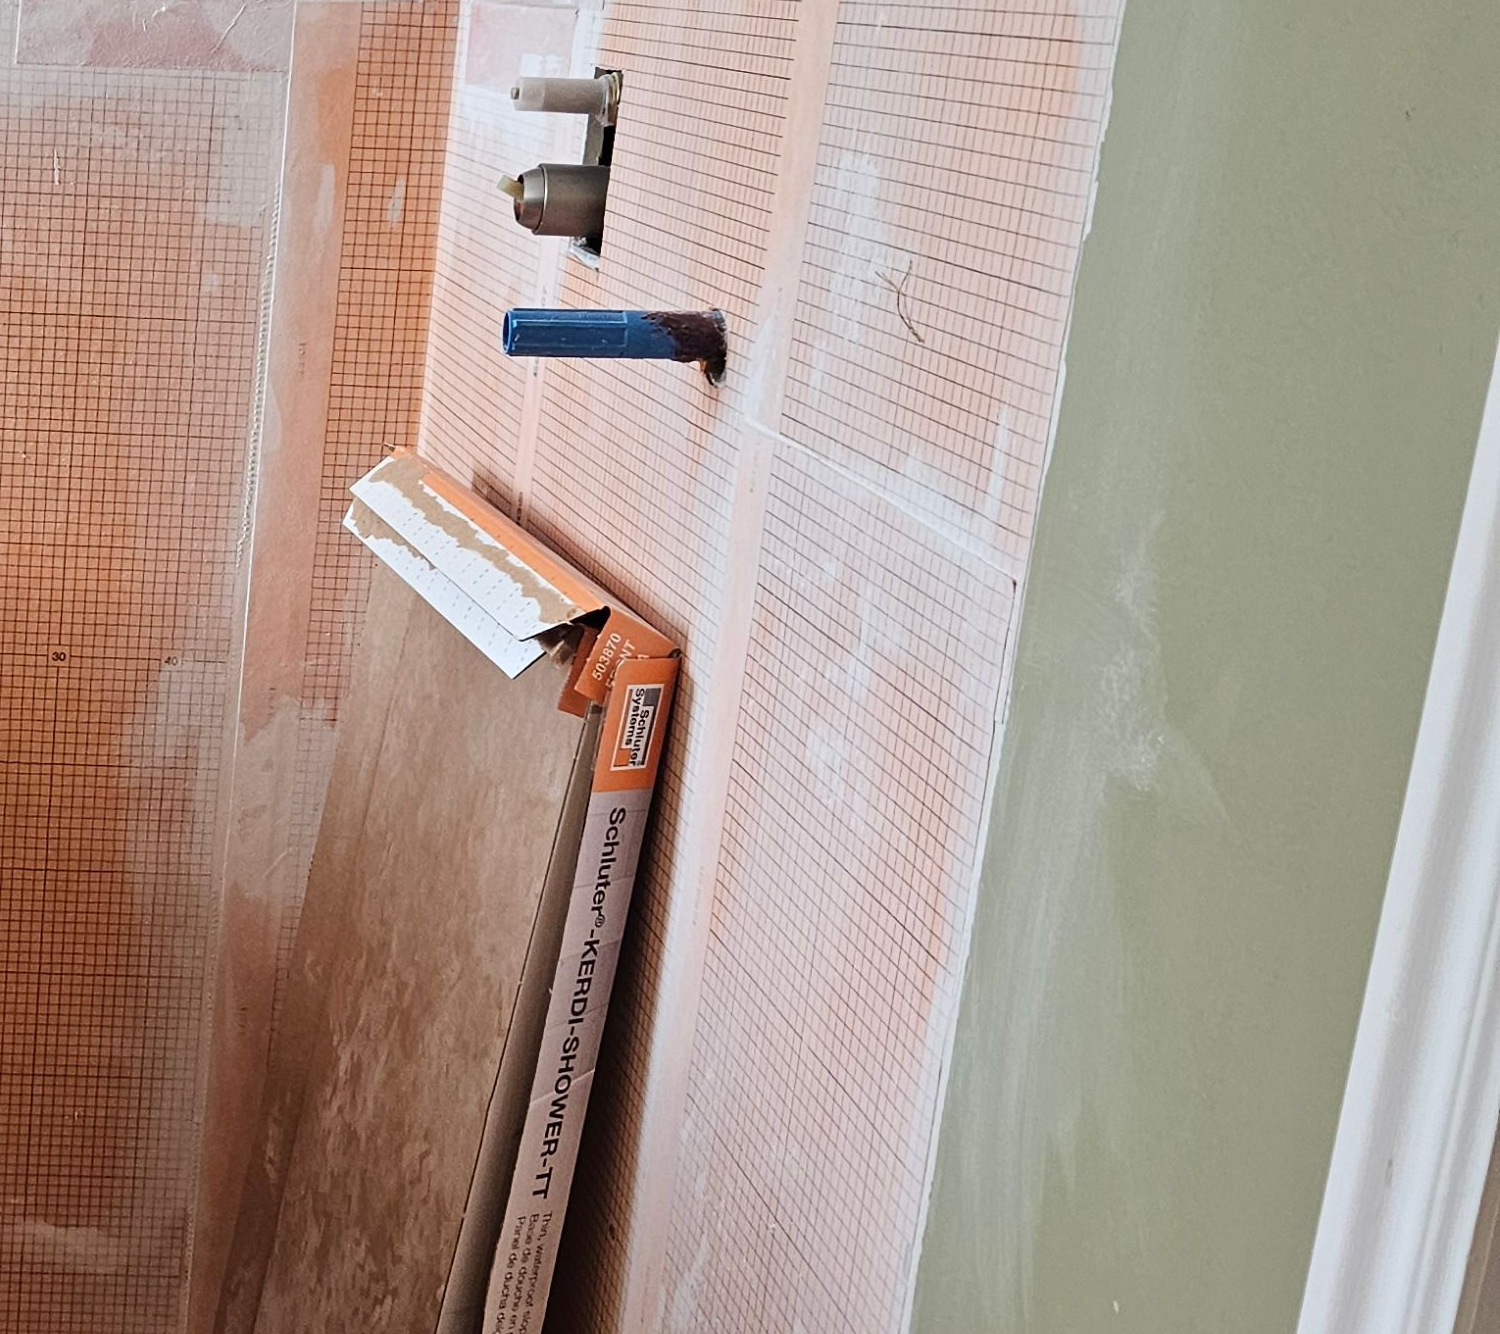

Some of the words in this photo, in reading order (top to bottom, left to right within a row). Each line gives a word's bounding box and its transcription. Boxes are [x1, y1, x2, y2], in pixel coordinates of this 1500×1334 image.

[52, 651, 67, 662] 30
[592, 633, 621, 681] 503870
[625, 688, 645, 747] Systems
[628, 708, 650, 767] Schluter
